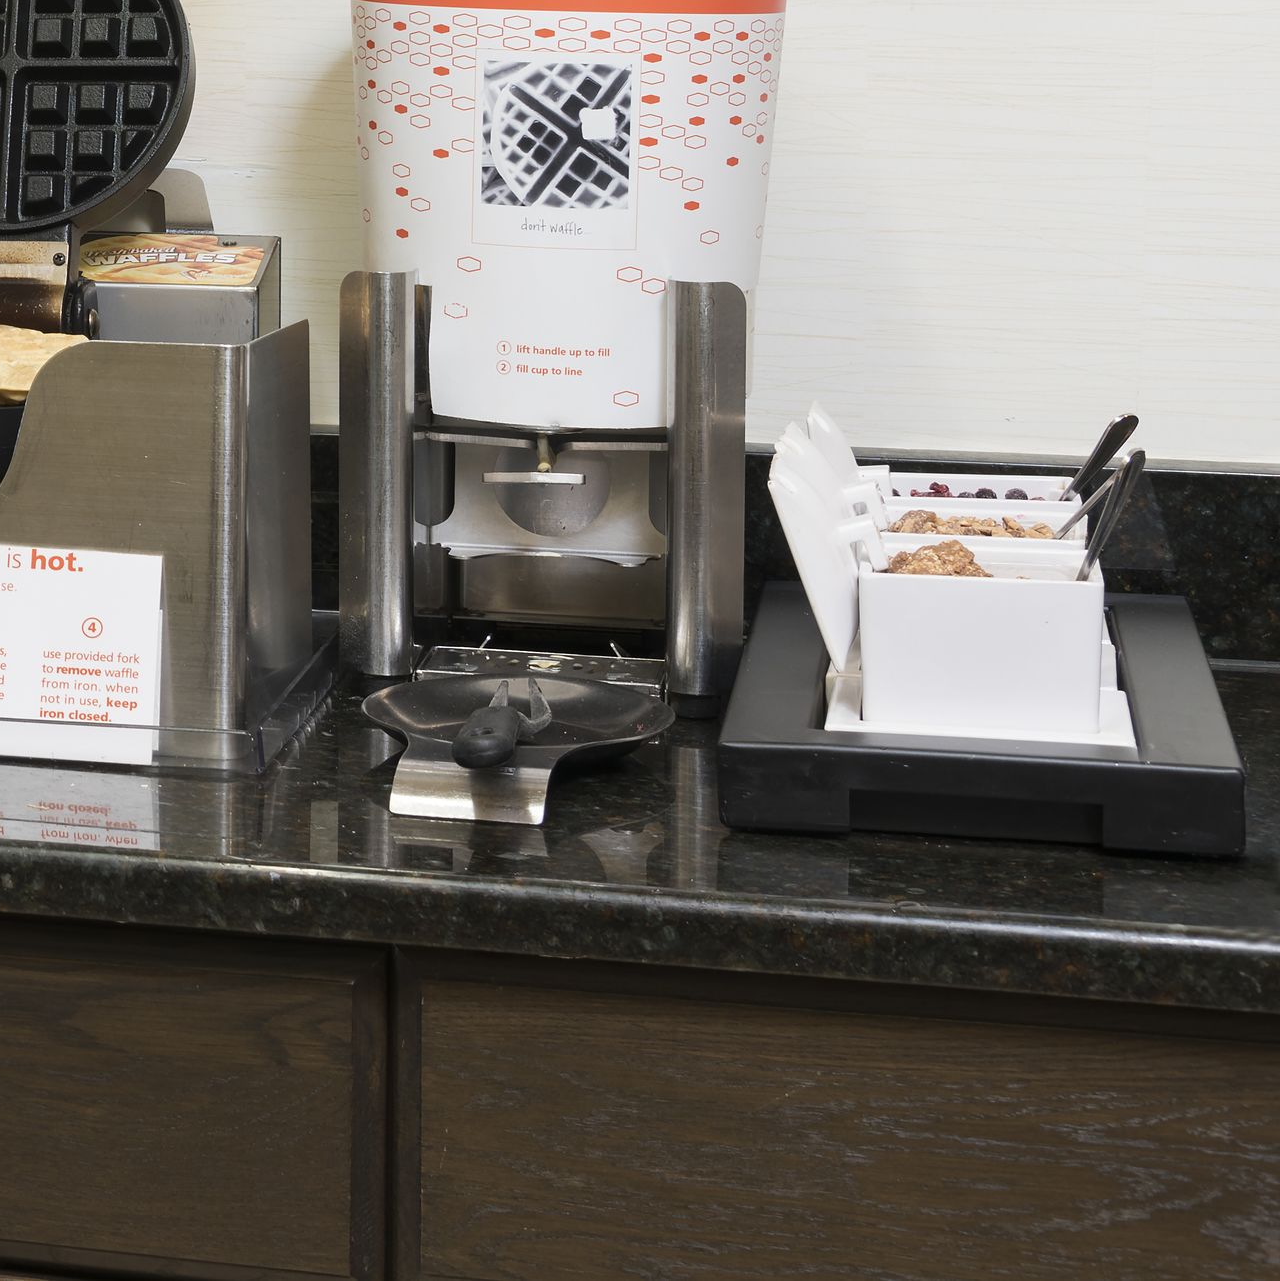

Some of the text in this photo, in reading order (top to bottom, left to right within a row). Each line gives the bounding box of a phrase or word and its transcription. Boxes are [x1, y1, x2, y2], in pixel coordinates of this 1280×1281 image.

[82, 253, 237, 266] WAFFLES
[516, 345, 530, 354] lift
[533, 346, 566, 356] handle
[569, 349, 582, 358] up
[585, 349, 595, 357] to
[598, 348, 610, 357] fill
[516, 364, 529, 373] fill
[531, 367, 548, 376] cup
[552, 367, 562, 375] to
[565, 367, 582, 376] line
[7, 547, 22, 569] is
[31, 548, 83, 572] hot.
[43, 650, 140, 664] use provided fork
[42, 664, 139, 679] to remove waffle
[41, 678, 139, 694] from iron. when
[40, 694, 138, 711] not in use, keep
[39, 707, 112, 722] iron closed.
